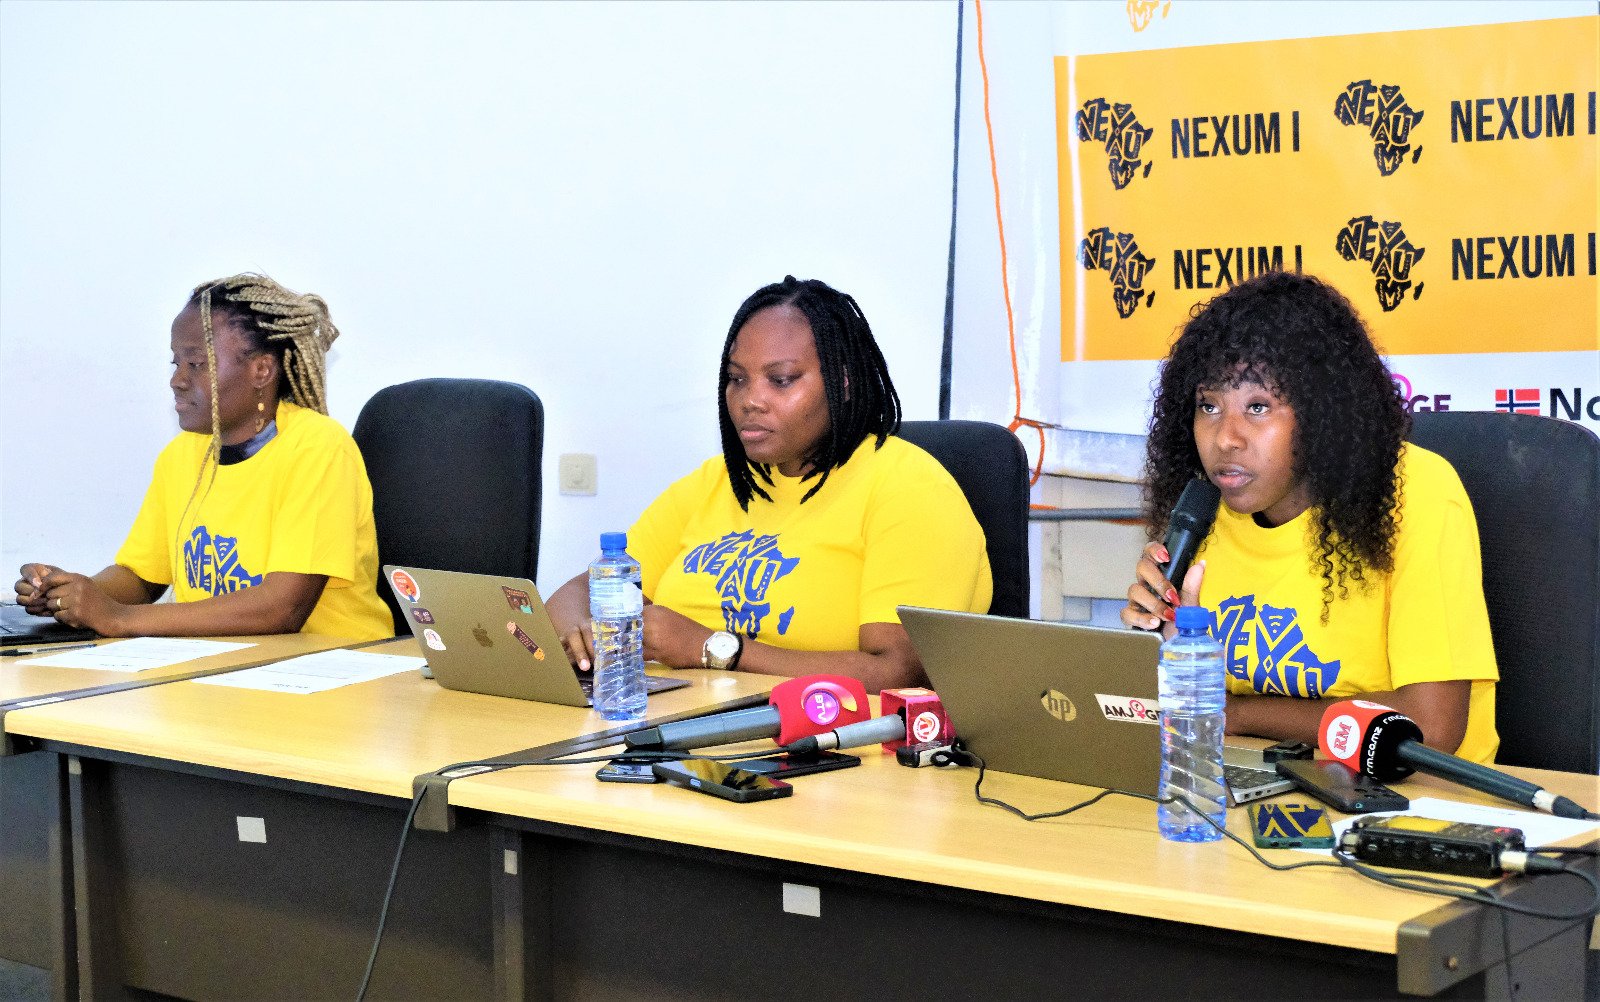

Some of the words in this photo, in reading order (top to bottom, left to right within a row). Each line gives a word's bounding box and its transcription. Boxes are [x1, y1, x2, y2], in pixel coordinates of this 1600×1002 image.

[1171, 112, 1281, 159] NEXUM
[1450, 93, 1575, 144] NEXUM
[1451, 233, 1576, 281] NEXUM
[1333, 721, 1352, 753] RM
